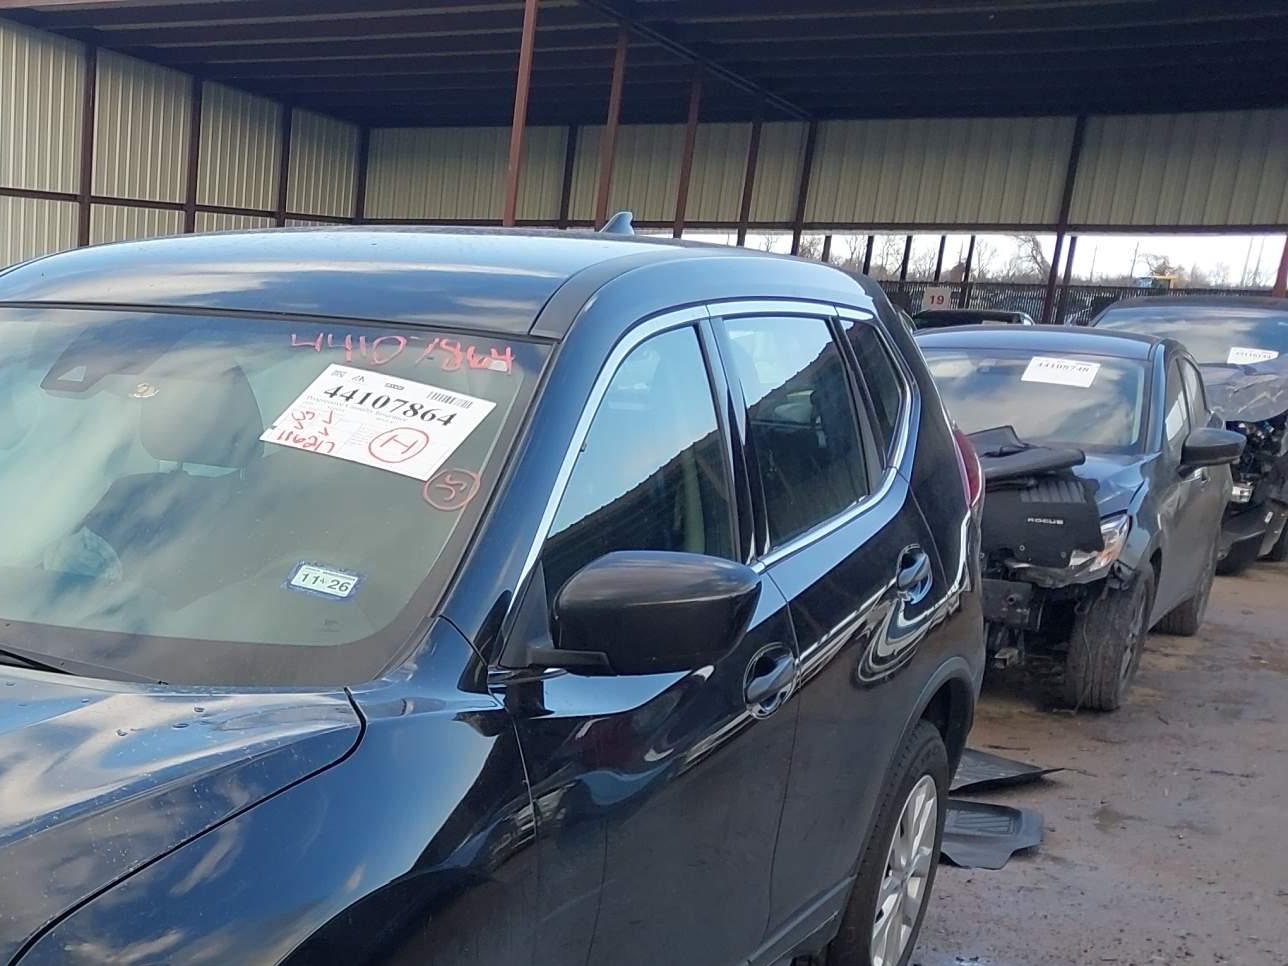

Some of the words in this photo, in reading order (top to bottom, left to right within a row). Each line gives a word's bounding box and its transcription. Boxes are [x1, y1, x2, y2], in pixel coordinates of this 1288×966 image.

[930, 295, 945, 304] 19
[323, 385, 457, 427] 44107864
[327, 579, 352, 592] 26
